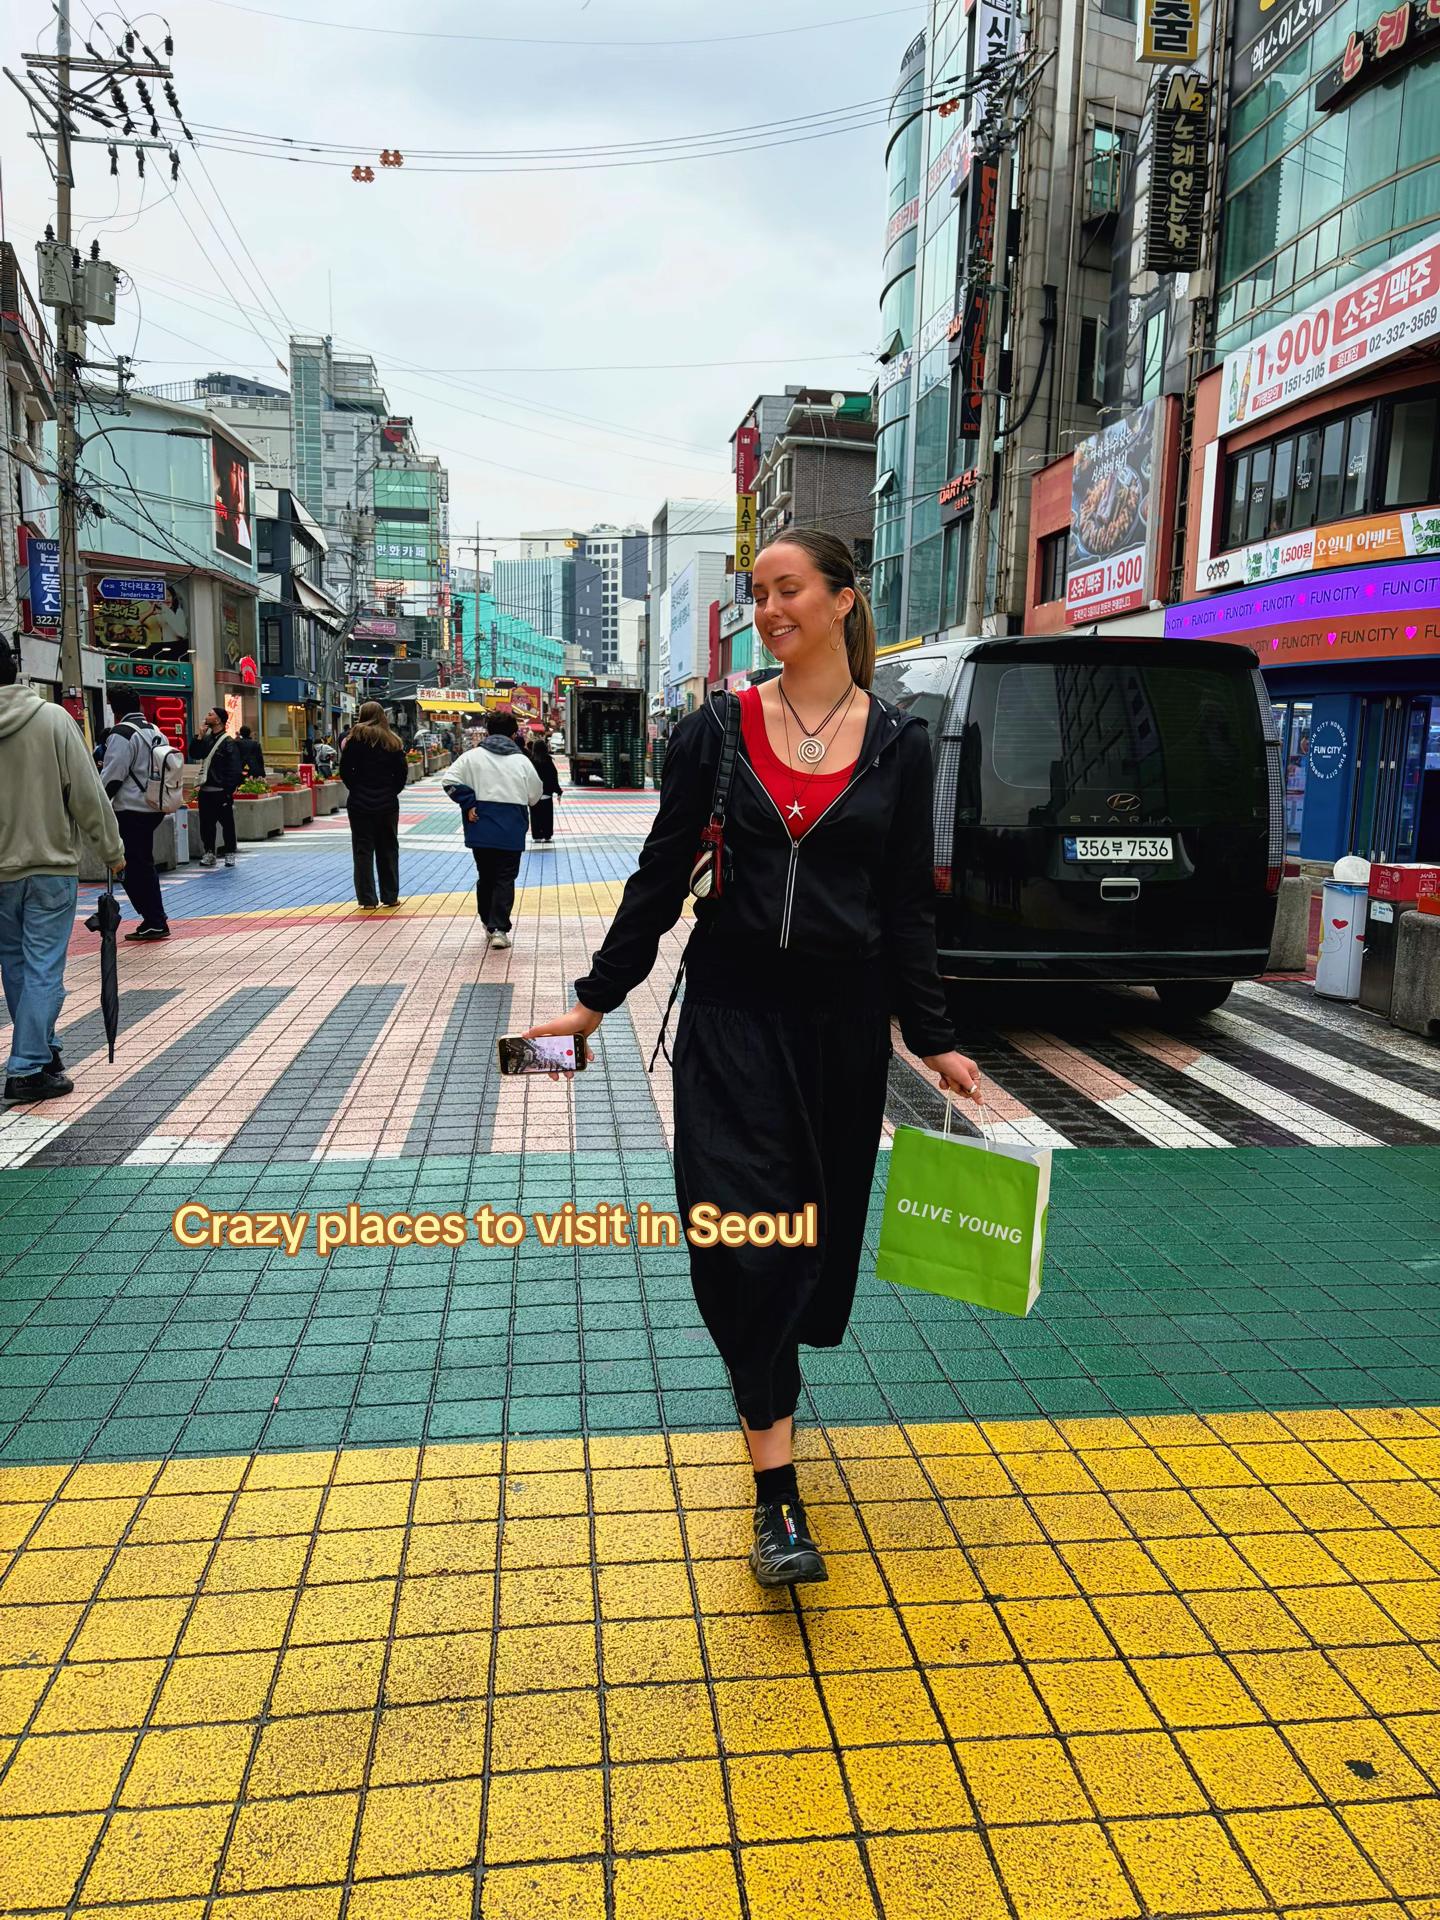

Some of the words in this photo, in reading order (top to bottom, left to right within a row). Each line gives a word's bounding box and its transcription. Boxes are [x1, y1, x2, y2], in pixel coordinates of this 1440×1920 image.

[1164, 114, 1195, 249] 노래연습장
[1256, 308, 1330, 386] 1,900
[1341, 255, 1432, 336] 소주/맥주
[1284, 362, 1326, 395] 1551-5105
[1369, 306, 1438, 354] 02-332-3569
[1315, 535, 1353, 557] 오일내
[1356, 527, 1401, 550] 이벤트
[1281, 542, 1313, 565] 1,500원
[39, 553, 62, 612] 부동산
[1107, 555, 1143, 592] 1,900
[119, 581, 164, 592] 잔다리로2길
[1310, 588, 1332, 605] FUN
[1333, 586, 1360, 602] CITY
[1382, 580, 1412, 596] FUN
[1413, 576, 1440, 594] CIT
[1225, 607, 1238, 620] FUN
[1236, 604, 1254, 617] CITY
[1262, 599, 1276, 612] FUN
[1276, 595, 1296, 609] CITY
[1281, 636, 1299, 649] FUN
[1299, 634, 1323, 648] CITY
[1340, 630, 1365, 644] FUN
[1365, 628, 1398, 643] CITY
[1314, 745, 1326, 754] FUN
[1326, 745, 1342, 754] CITY
[1069, 815, 1173, 823] STARIA
[1079, 840, 1123, 857] 356부
[1127, 840, 1169, 857] 7536
[897, 1198, 953, 1224] OLIVE
[958, 1212, 1023, 1244] YOUNG
